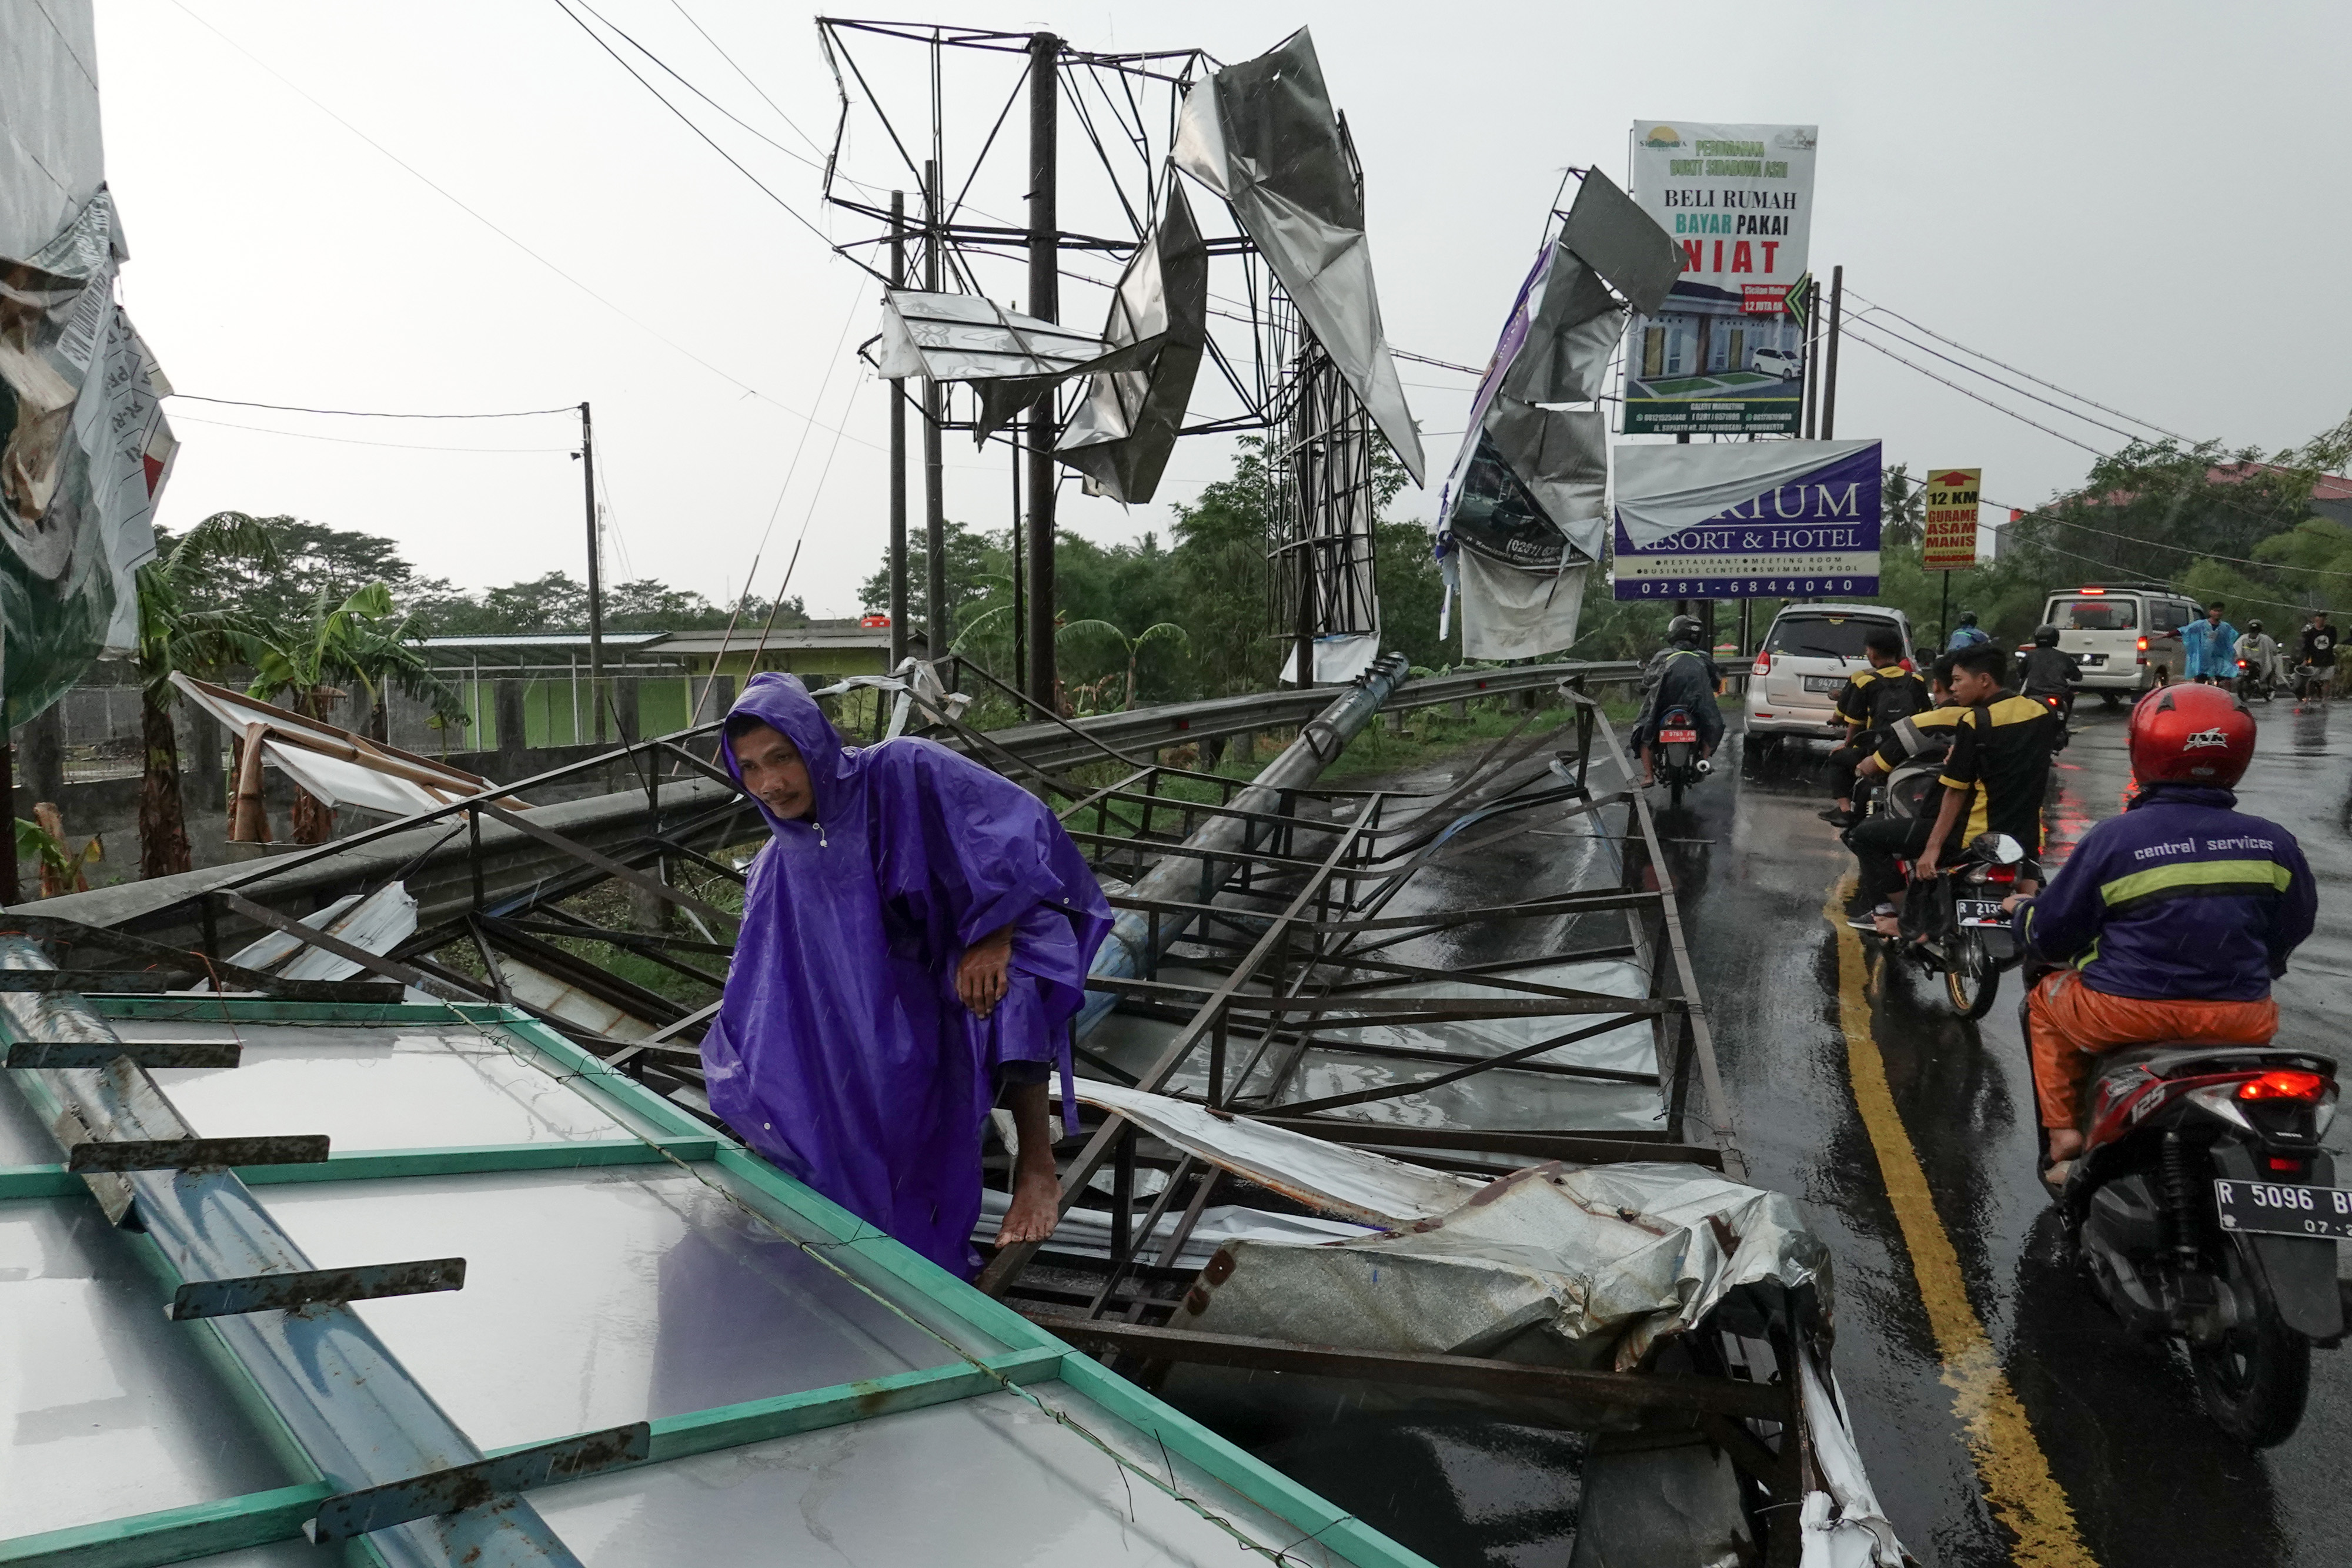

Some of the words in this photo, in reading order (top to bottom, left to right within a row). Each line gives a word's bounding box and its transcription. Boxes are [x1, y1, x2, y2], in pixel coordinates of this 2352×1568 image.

[1665, 189, 1715, 207] BELI
[1722, 190, 1797, 209] RUMAH
[1676, 213, 1732, 234] BAYAR
[1736, 215, 1788, 235] PAKAI
[1682, 239, 1779, 273] NIAT
[1929, 492, 1948, 505] 12
[1952, 491, 1977, 504] KM
[1928, 509, 1976, 523] GURAME
[1927, 522, 1976, 535] ASAM
[1742, 531, 1763, 549] &
[1772, 529, 1860, 549] HOTEL
[1926, 536, 1975, 548] MANIS
[2134, 837, 2196, 860] central
[2206, 835, 2273, 851] services
[1959, 902, 1967, 913] R
[2219, 1182, 2234, 1205] R
[2251, 1184, 2314, 1211] 5096
[2331, 1191, 2352, 1215] B
